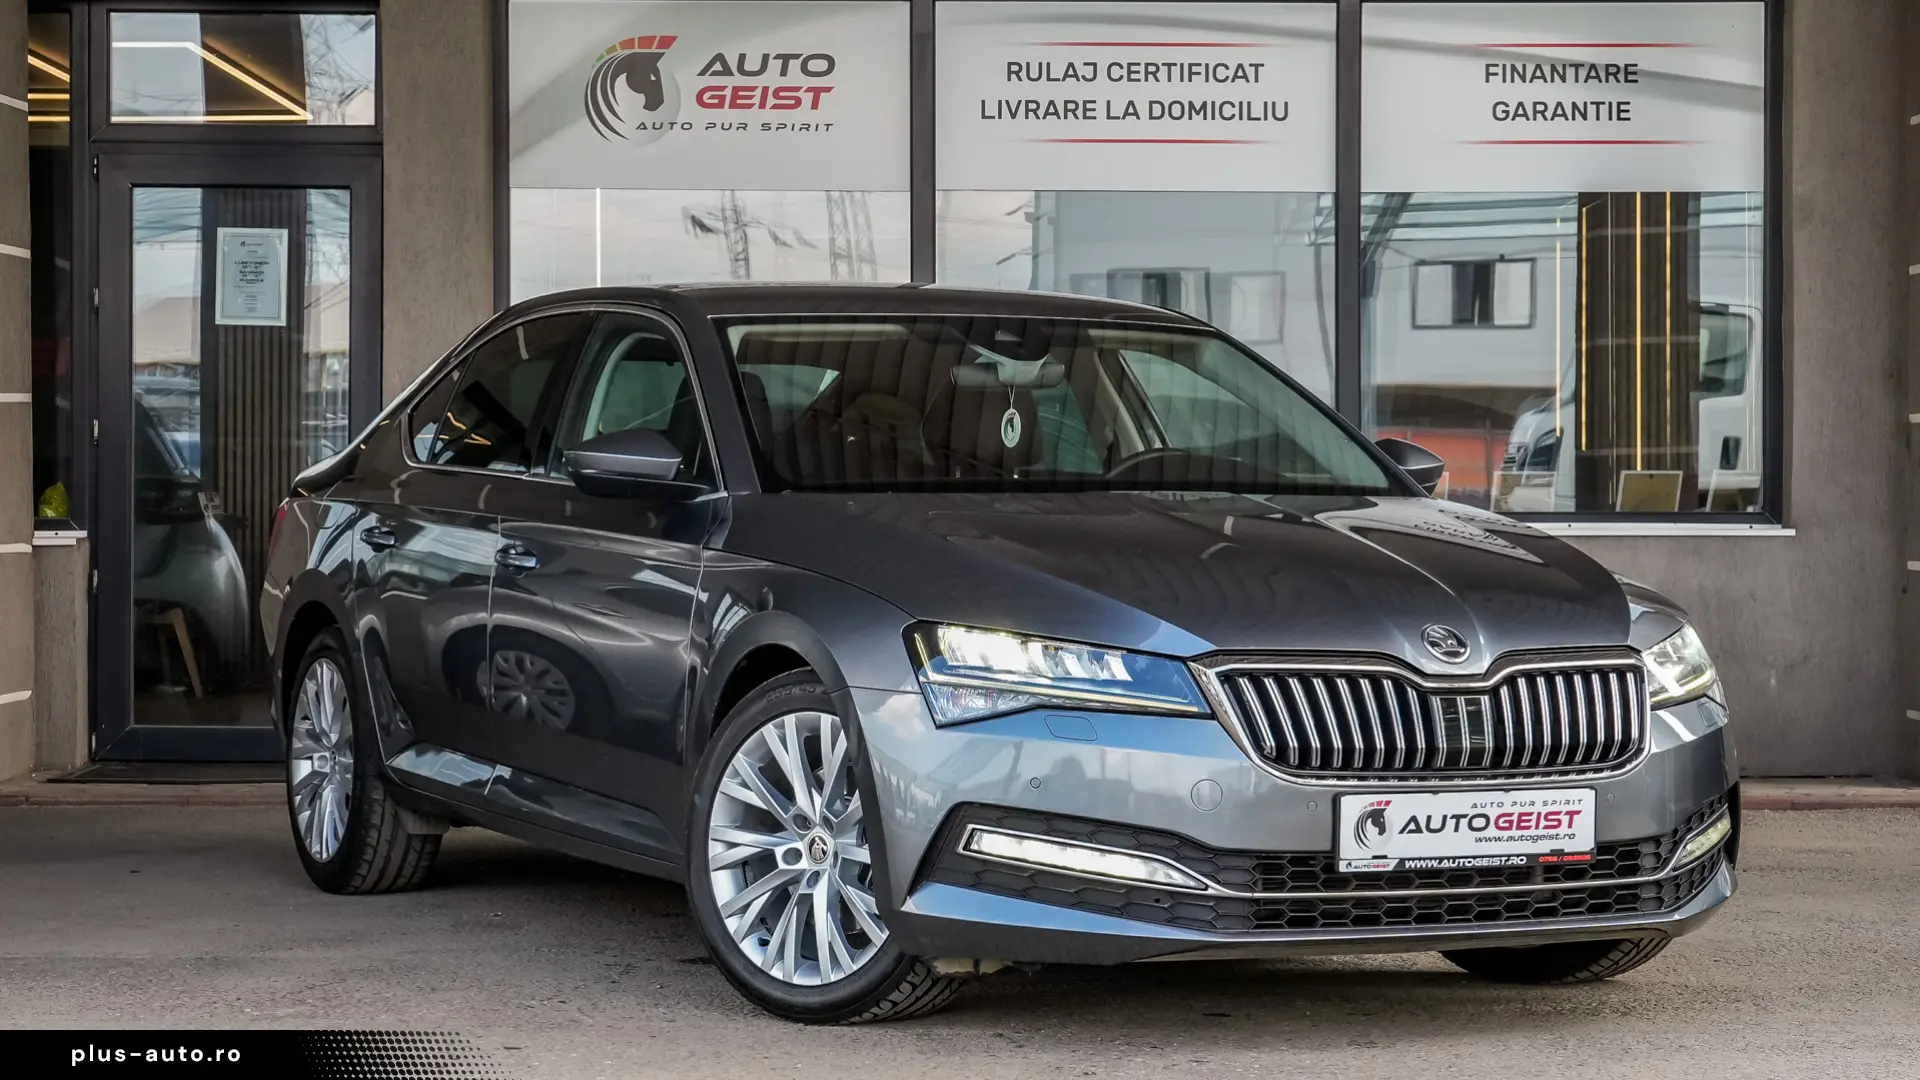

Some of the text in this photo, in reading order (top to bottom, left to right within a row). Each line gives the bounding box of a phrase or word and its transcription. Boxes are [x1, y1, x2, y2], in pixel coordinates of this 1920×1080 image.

[696, 52, 836, 78] AUTO
[1006, 61, 1265, 84] RULAJ CERTIFICAT
[1484, 63, 1639, 84] FINANTARE
[695, 85, 835, 110] GEIST
[980, 99, 1289, 122] LIVRARE LA DOMICILIU
[1492, 101, 1632, 122] GARANTIE
[635, 121, 835, 132] AUTO PUR SPIRIT
[1470, 799, 1584, 809] AUTO PUR SPIRIT
[1474, 832, 1576, 844] www.autogeist.ro
[1404, 856, 1527, 869] WWW.AUTOGEIST.RO
